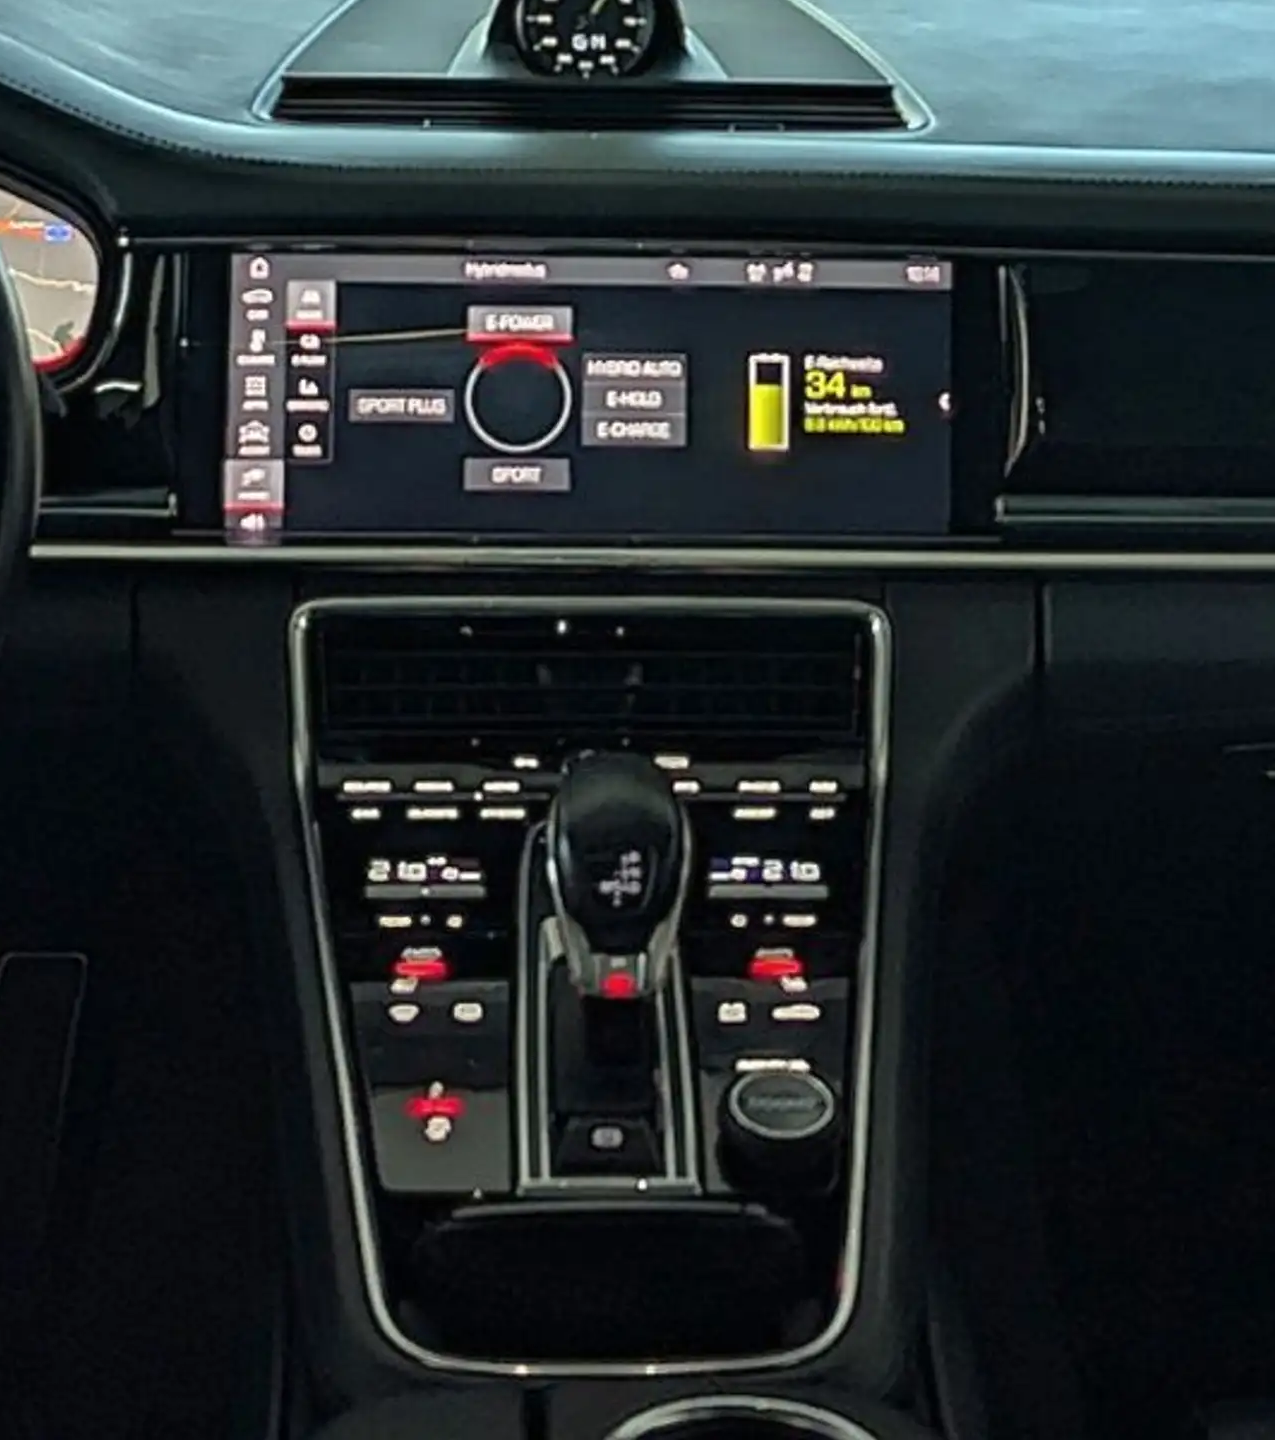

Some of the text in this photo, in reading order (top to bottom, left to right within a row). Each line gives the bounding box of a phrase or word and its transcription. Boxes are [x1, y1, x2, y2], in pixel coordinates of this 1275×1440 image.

[485, 313, 554, 331] E-POWER
[586, 360, 683, 377] HYBRID AUTO
[805, 371, 846, 399] 34
[357, 397, 447, 415] SPORT PLUS
[606, 390, 663, 408] E-HOLD
[596, 421, 672, 439] E-CHARGE
[492, 466, 542, 483] SPORT
